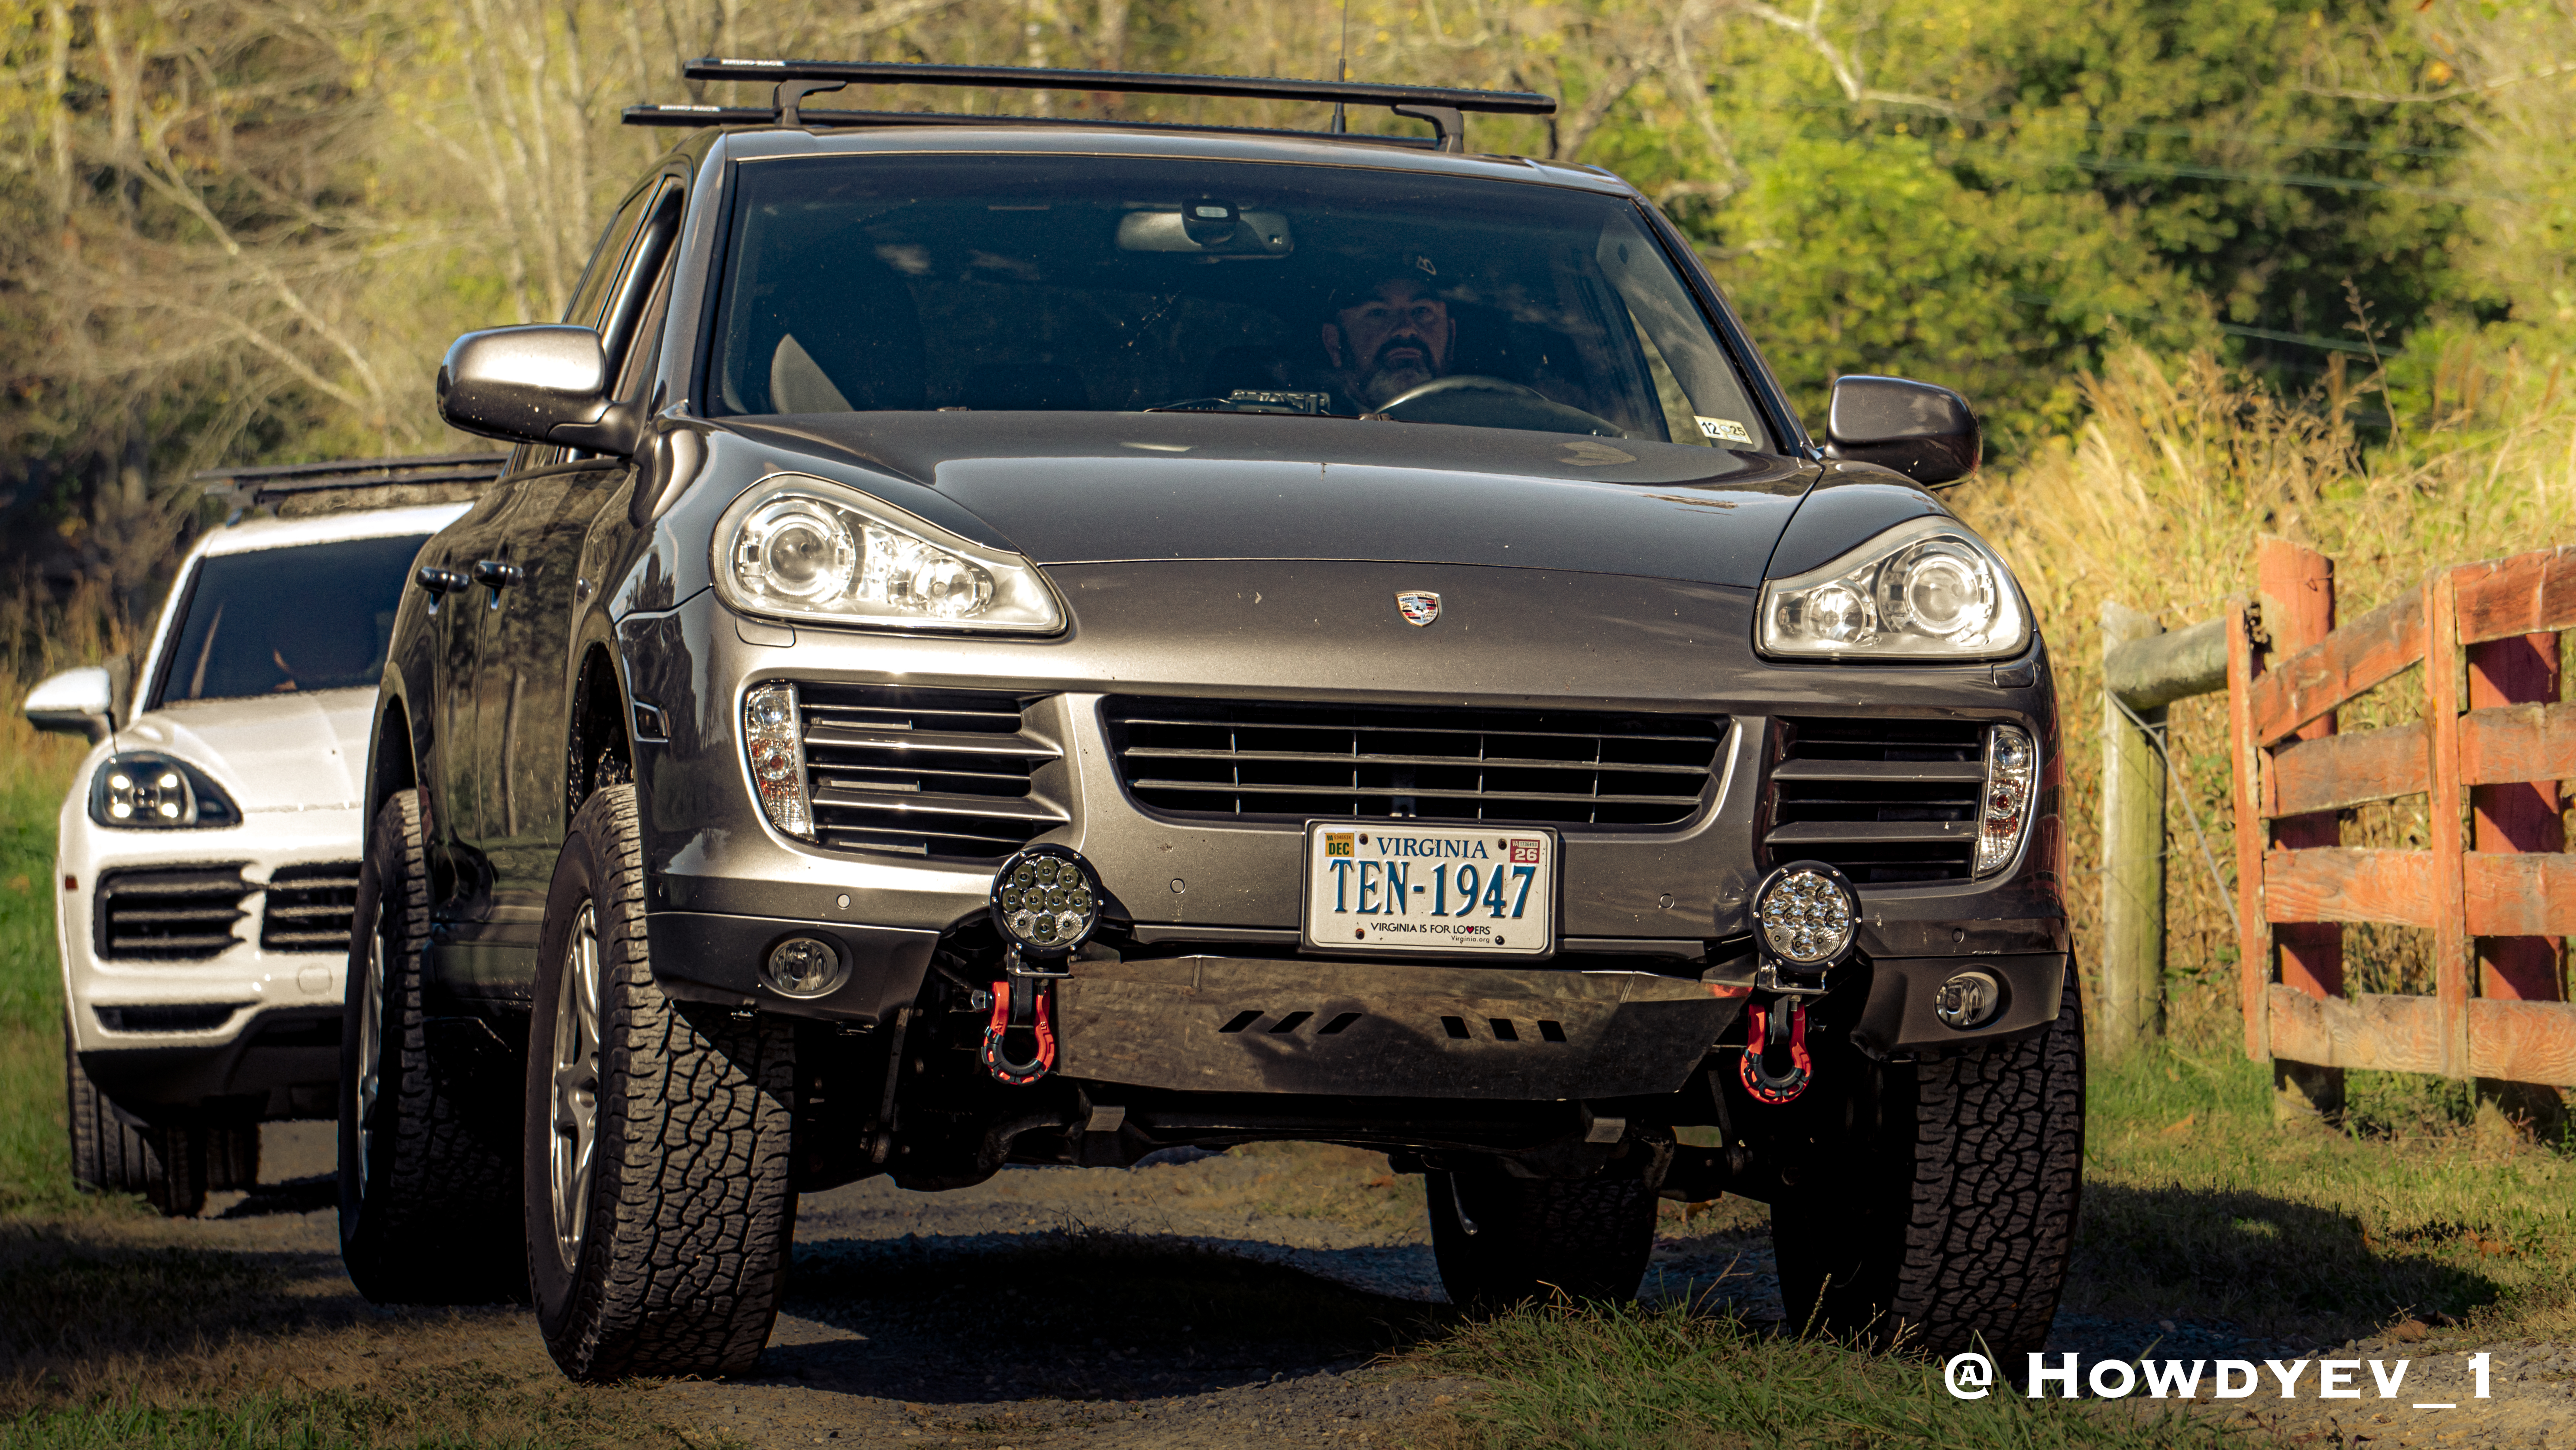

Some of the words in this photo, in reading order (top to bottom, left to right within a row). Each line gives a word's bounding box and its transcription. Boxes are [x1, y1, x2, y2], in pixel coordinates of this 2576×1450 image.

[1702, 422, 1720, 435] 12
[1730, 426, 1746, 436] 25
[1329, 842, 1349, 855] DEC
[1376, 837, 1489, 859] VIRGINIA
[1515, 848, 1537, 861] 26
[1329, 859, 1536, 918] TEN-1947
[1370, 922, 1417, 932] VIRGINIA
[1420, 924, 1427, 933] IS
[1430, 924, 1451, 934] FOR
[1451, 935, 1490, 944] Virginia.org
